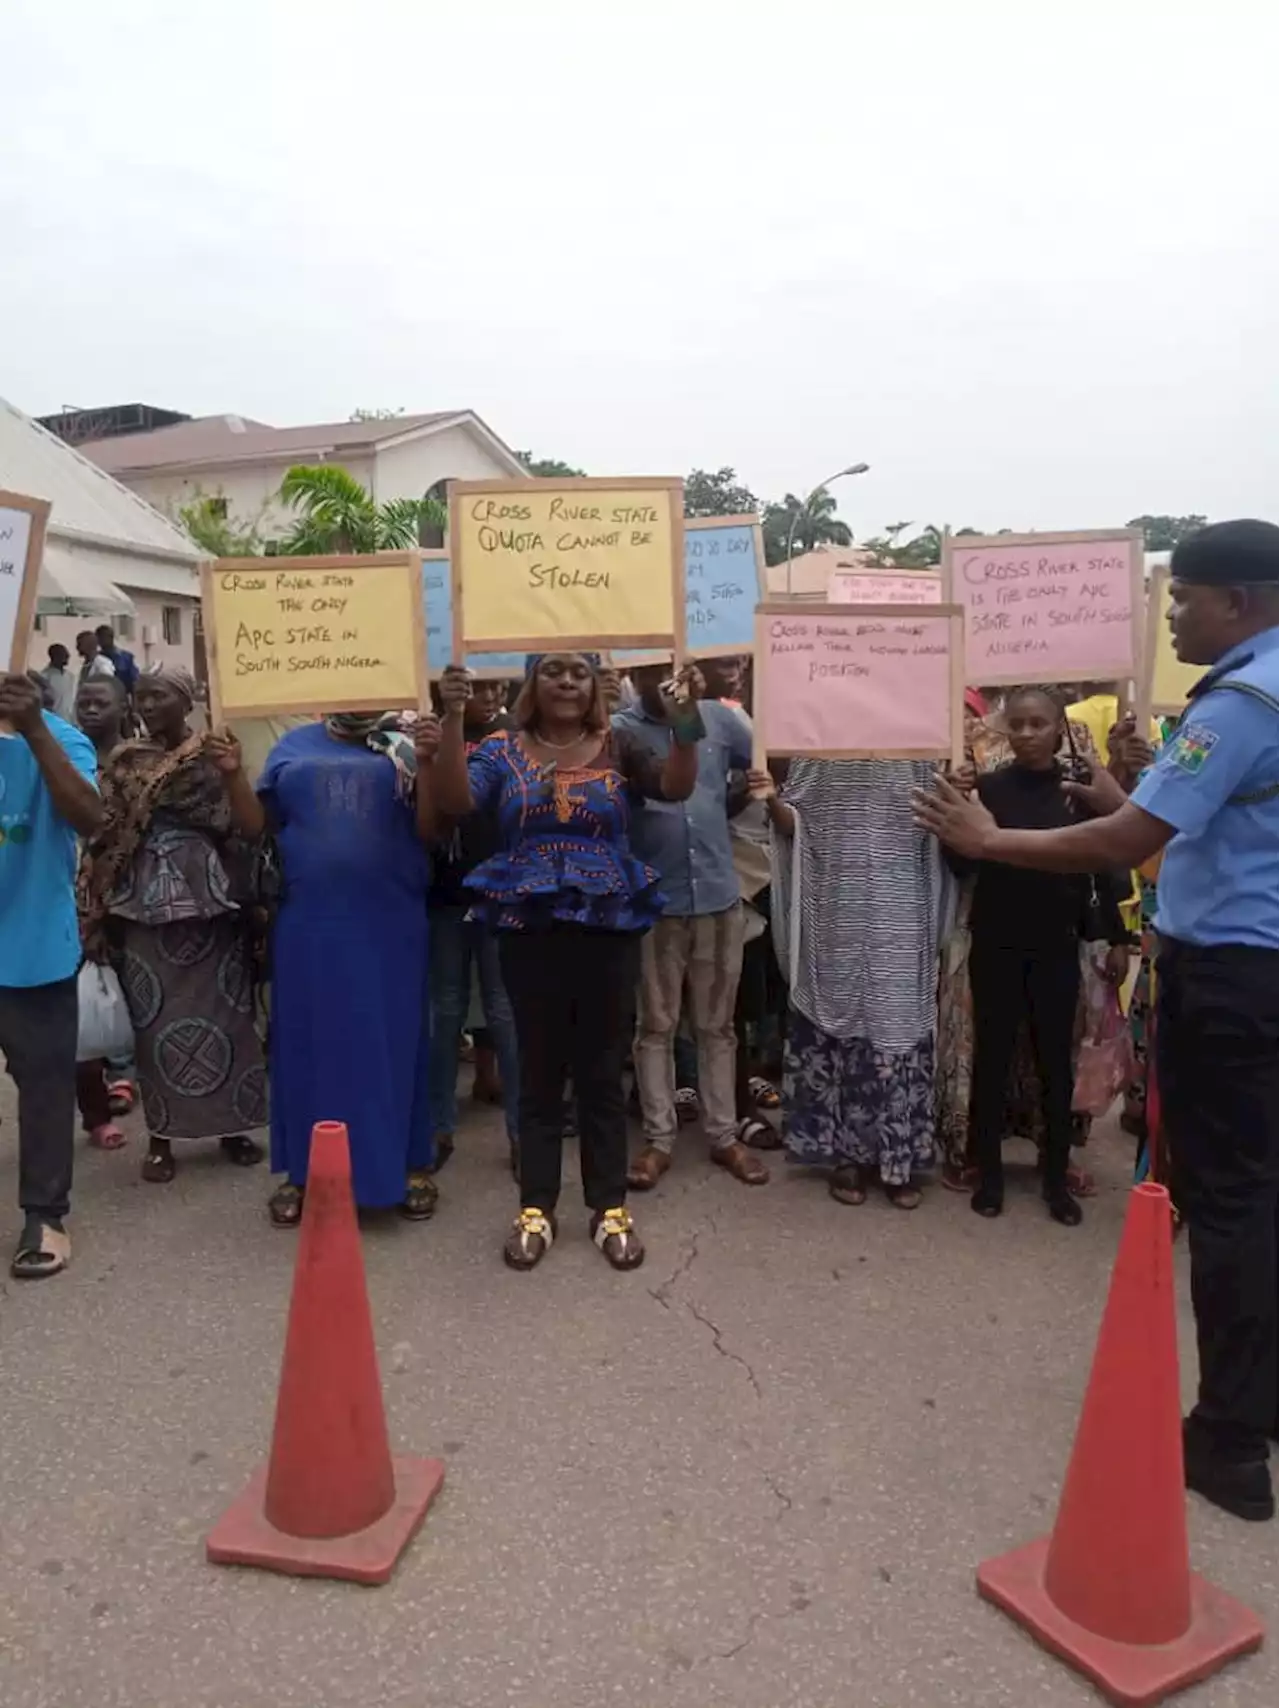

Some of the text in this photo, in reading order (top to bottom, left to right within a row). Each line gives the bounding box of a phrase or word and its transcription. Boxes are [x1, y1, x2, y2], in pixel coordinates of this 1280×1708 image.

[471, 497, 659, 523] CROSS RIVER STATE
[478, 525, 653, 553] QUOTA CANNOT BE
[219, 573, 267, 592] CROSS
[528, 563, 610, 589] STOLEN
[963, 556, 1125, 585] CROSS RIVER STATE
[276, 596, 349, 616] THE ONLY
[971, 593, 984, 606] IS
[996, 585, 1022, 605] THE
[1026, 583, 1069, 600] ONLY
[972, 612, 1012, 635] STATE
[1021, 611, 1038, 628] IN
[1048, 605, 1097, 627] SOUTH
[235, 621, 358, 650] APC STATE IN
[234, 652, 280, 677] SOUTH
[286, 657, 332, 673] SOUTH
